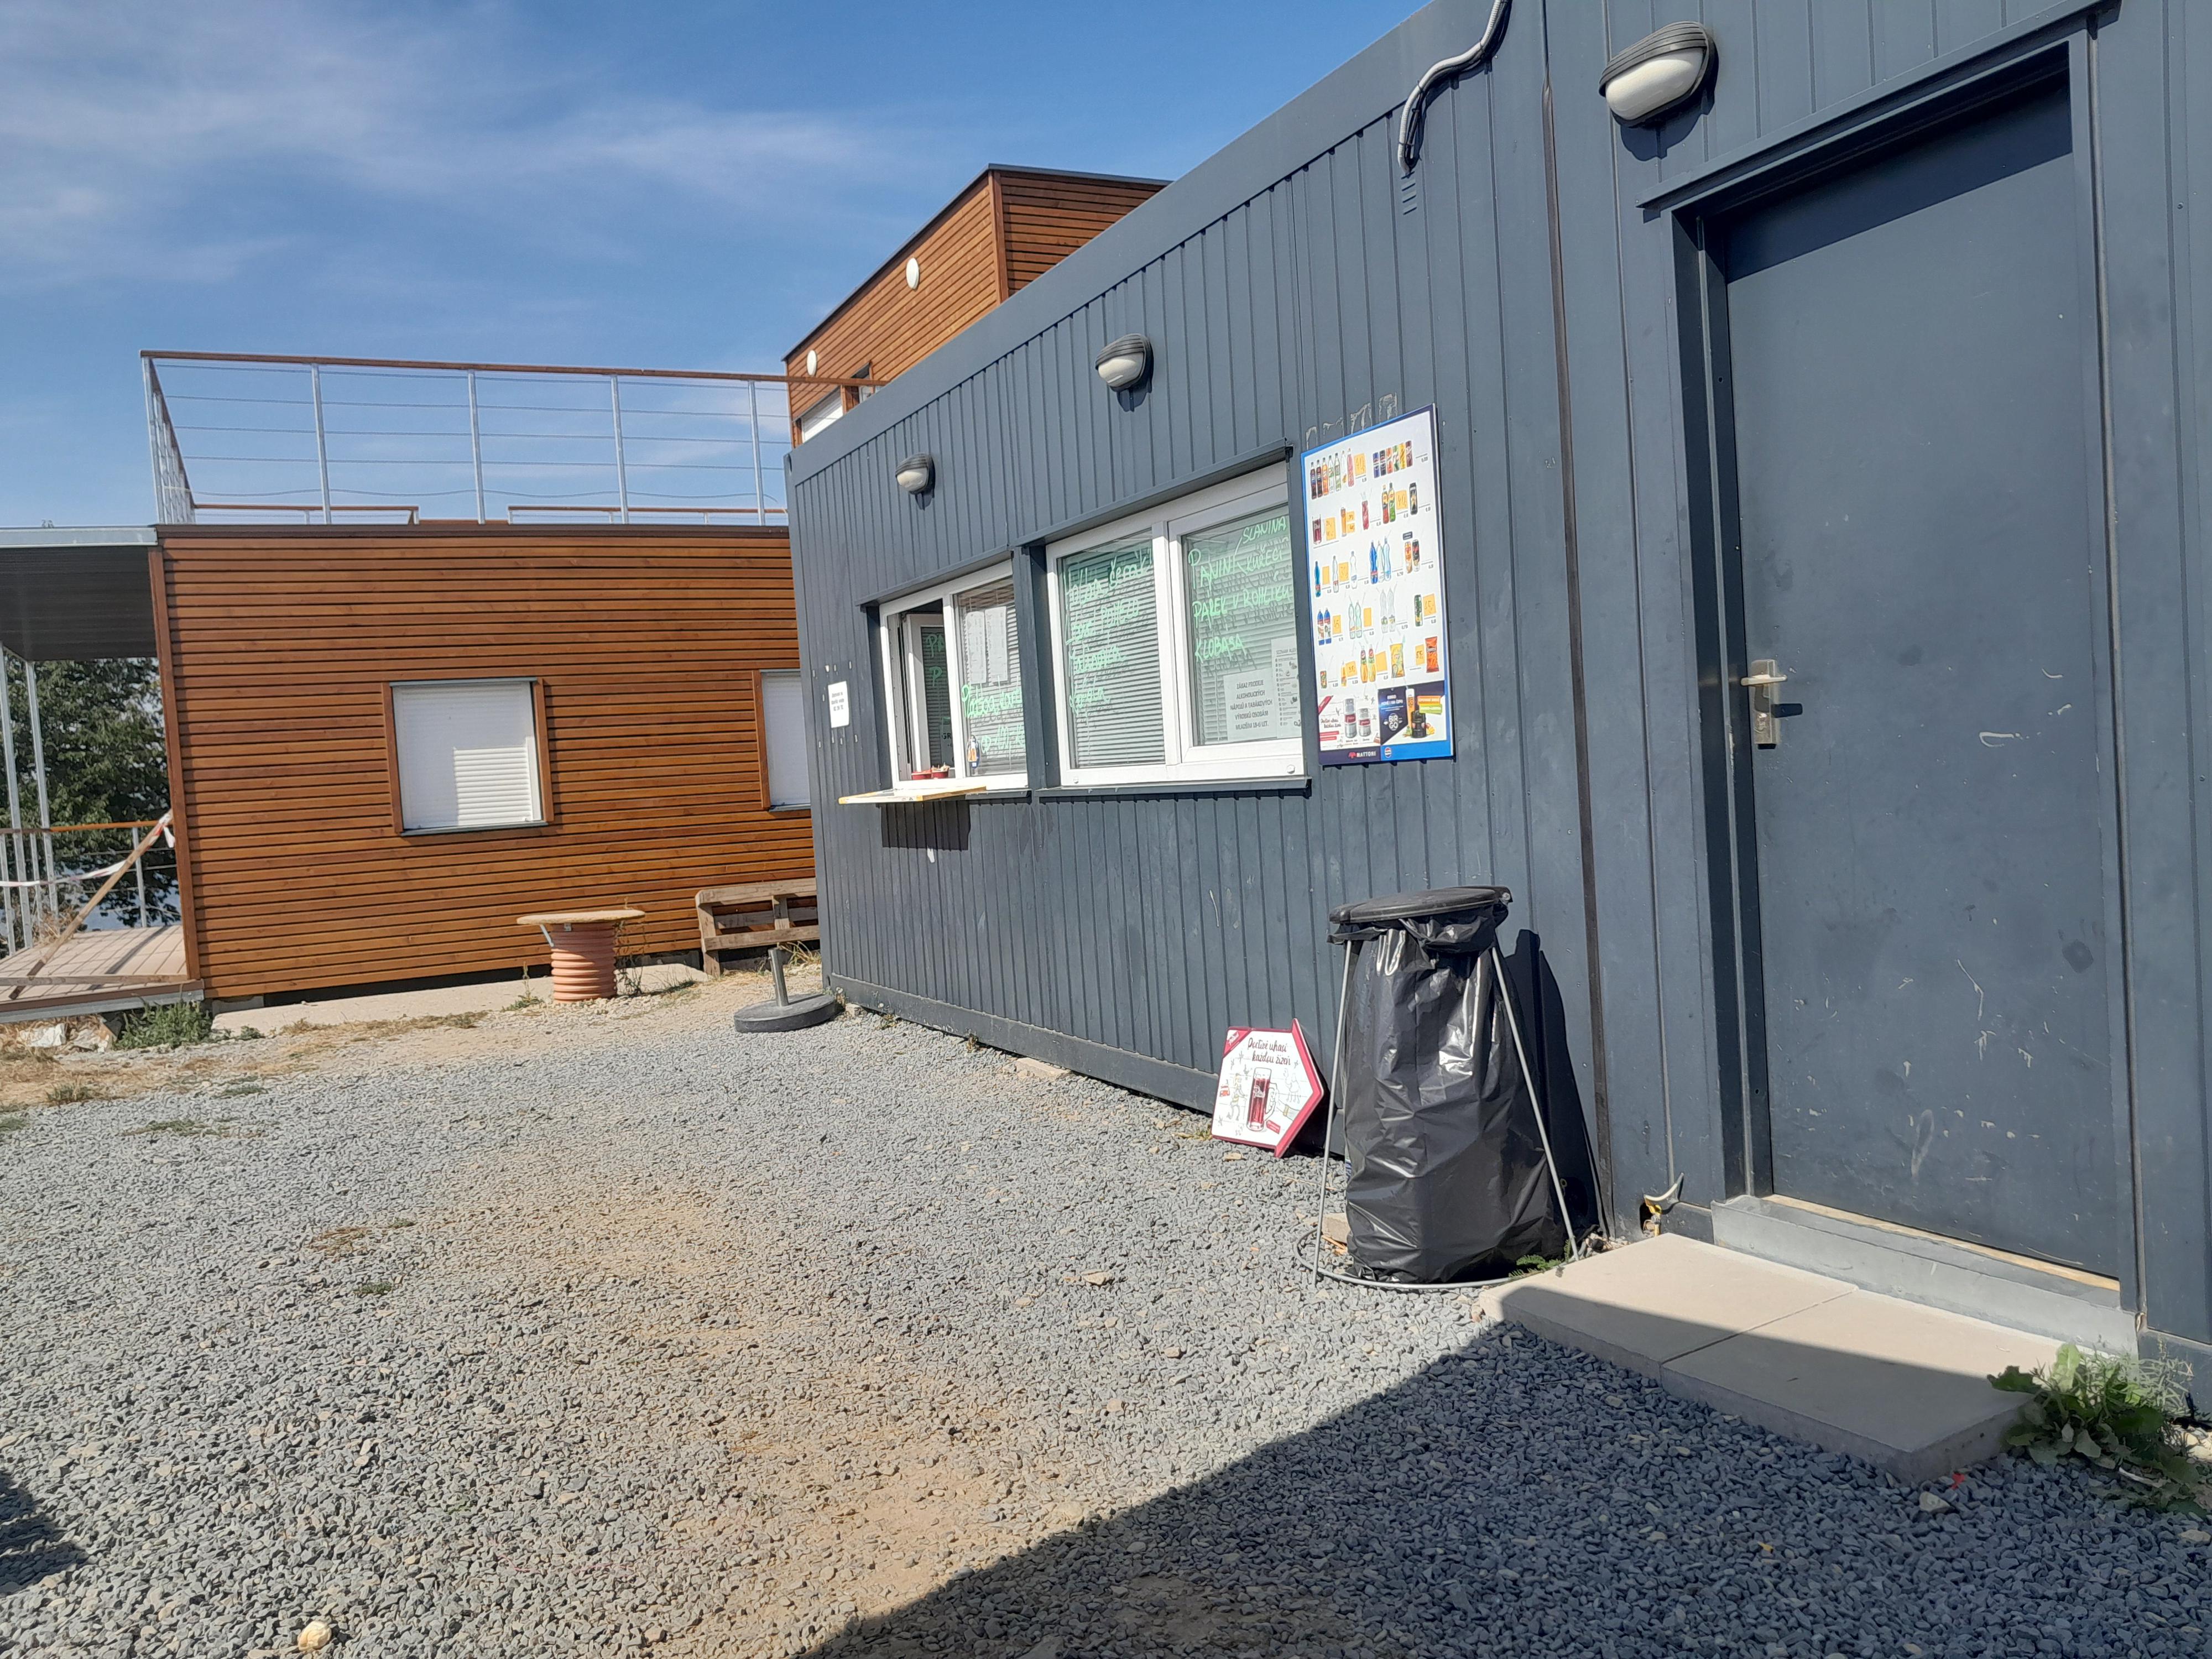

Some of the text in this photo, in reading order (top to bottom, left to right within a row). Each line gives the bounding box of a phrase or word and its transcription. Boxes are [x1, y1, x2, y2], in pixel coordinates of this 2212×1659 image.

[1243, 516, 1287, 544] SLANINA
[1188, 548, 1235, 591] PANINI
[1237, 679, 1264, 690] ZÁKAZ PRODEJE
